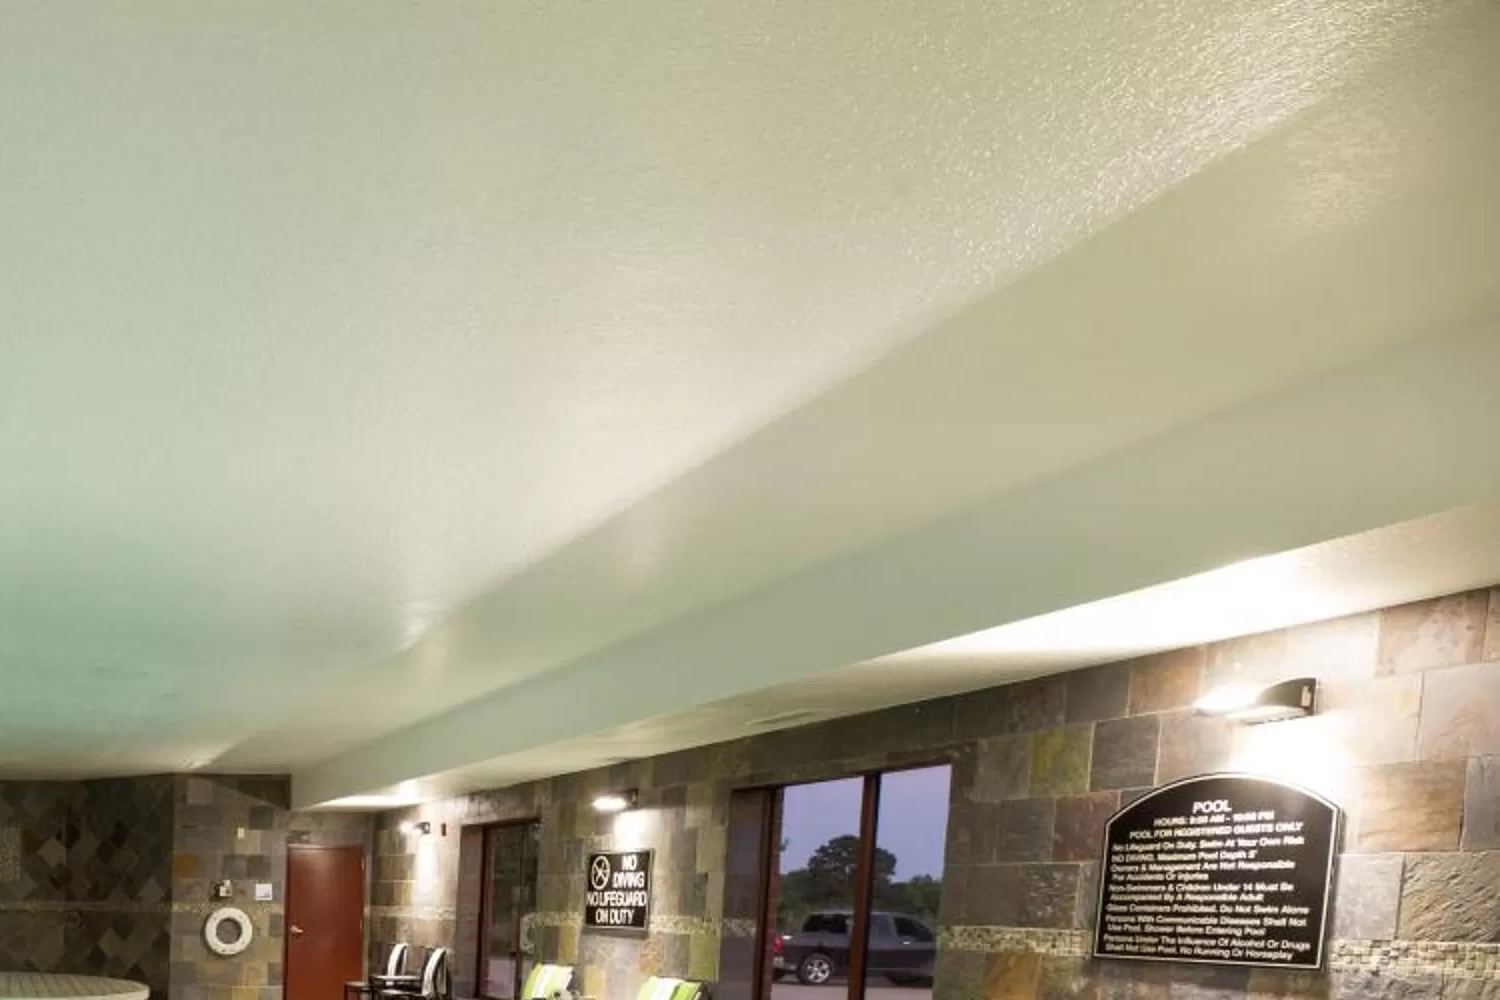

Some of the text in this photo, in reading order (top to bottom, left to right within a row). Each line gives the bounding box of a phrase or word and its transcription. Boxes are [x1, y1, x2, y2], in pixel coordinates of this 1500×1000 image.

[1192, 800, 1232, 814] POOL
[1129, 821, 1304, 839] POOL FOR REGISTERED GUESTS ONLY
[1125, 843, 1161, 853] Lifeguard
[1161, 841, 1175, 850] On
[1199, 839, 1223, 849] Swim
[1225, 838, 1235, 847] At
[1237, 837, 1258, 847] Your
[1260, 836, 1281, 847] Own
[1198, 851, 1219, 860] Pool
[1219, 850, 1246, 860] Depth
[622, 854, 637, 871] NO
[1141, 864, 1147, 872] &
[1148, 862, 1201, 872] Management
[1202, 861, 1218, 870] Are
[1219, 861, 1236, 870] Not
[1237, 860, 1296, 871] Responsible
[612, 871, 645, 889] DIVING
[1126, 873, 1165, 881] Accidents
[1165, 872, 1177, 881] Or
[1168, 884, 1175, 892] &
[1176, 884, 1211, 892] Children
[1213, 883, 1241, 891] Under
[1255, 882, 1279, 891] Must
[1280, 882, 1294, 891] Be
[586, 891, 647, 907] NO LIFEGUARD
[1110, 894, 1163, 902] Accompanied
[1163, 894, 1175, 902] By
[1184, 894, 1238, 902] Responsible
[1239, 893, 1265, 901] Adult
[595, 908, 634, 924] ON DUTY
[1220, 904, 1233, 913] Do
[1235, 905, 1252, 913] Not
[1253, 905, 1279, 914] Swim
[1105, 914, 1307, 927] Persons With Communicable Diseases Shall Not
[1175, 925, 1204, 934] Before
[1205, 926, 1242, 936] Entering
[1243, 927, 1266, 936] Pool
[1160, 935, 1176, 944] The
[1177, 936, 1217, 946] Influence
[1217, 938, 1229, 947] Of
[1230, 939, 1265, 948] Alcohol
[1267, 940, 1280, 949] Or
[1281, 940, 1311, 952] Drugs
[1193, 947, 1231, 958] Running
[1231, 948, 1242, 957] Or
[1245, 949, 1294, 961] Horseplay
